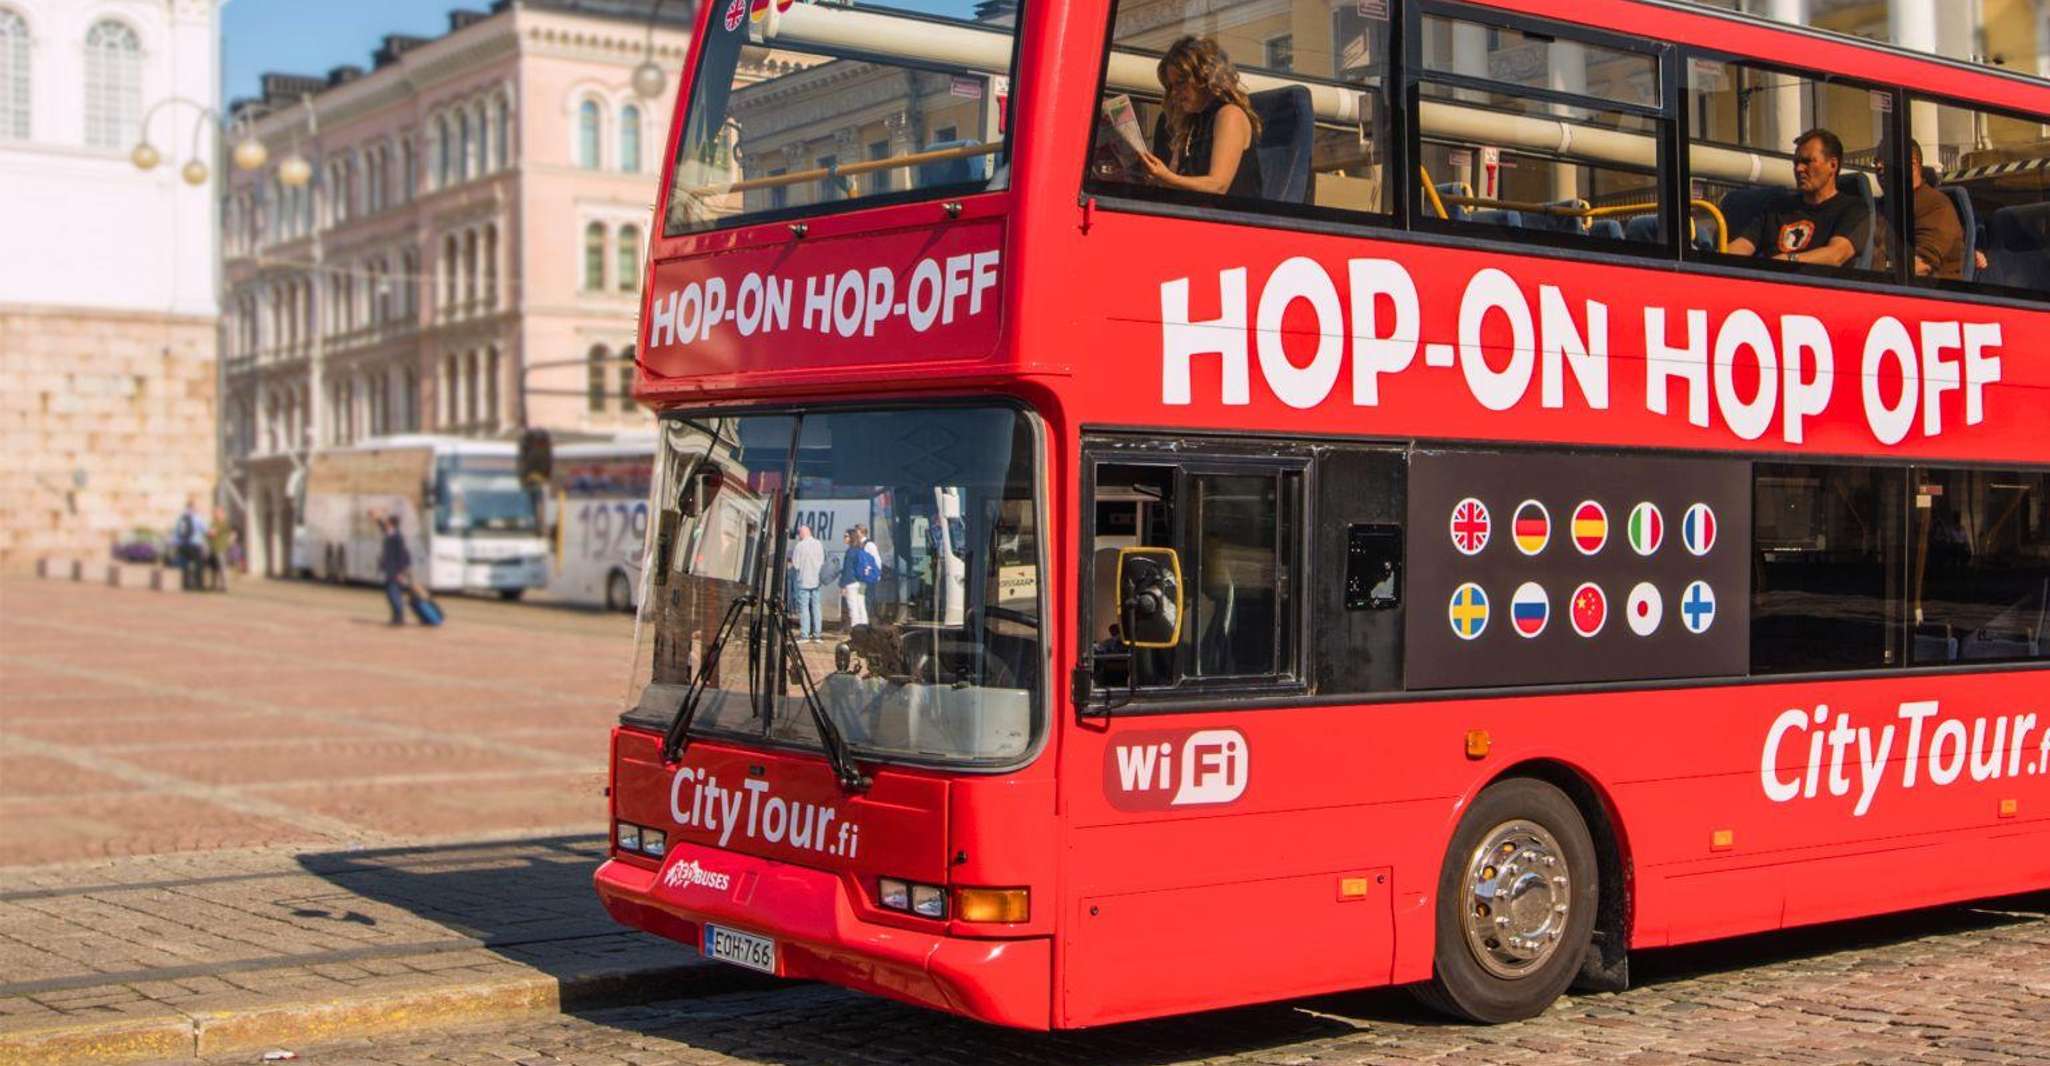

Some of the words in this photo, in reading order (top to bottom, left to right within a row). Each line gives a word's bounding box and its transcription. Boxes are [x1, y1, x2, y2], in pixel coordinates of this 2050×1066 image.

[650, 272, 793, 348] HOP-ON
[803, 250, 1000, 338] HOP-OFF
[1160, 256, 1609, 411] HOP-ON
[1644, 306, 1834, 445] HOP
[1862, 315, 2003, 446] OFF
[669, 766, 860, 860] CityTour.fi
[716, 931, 770, 966] EOH-766
